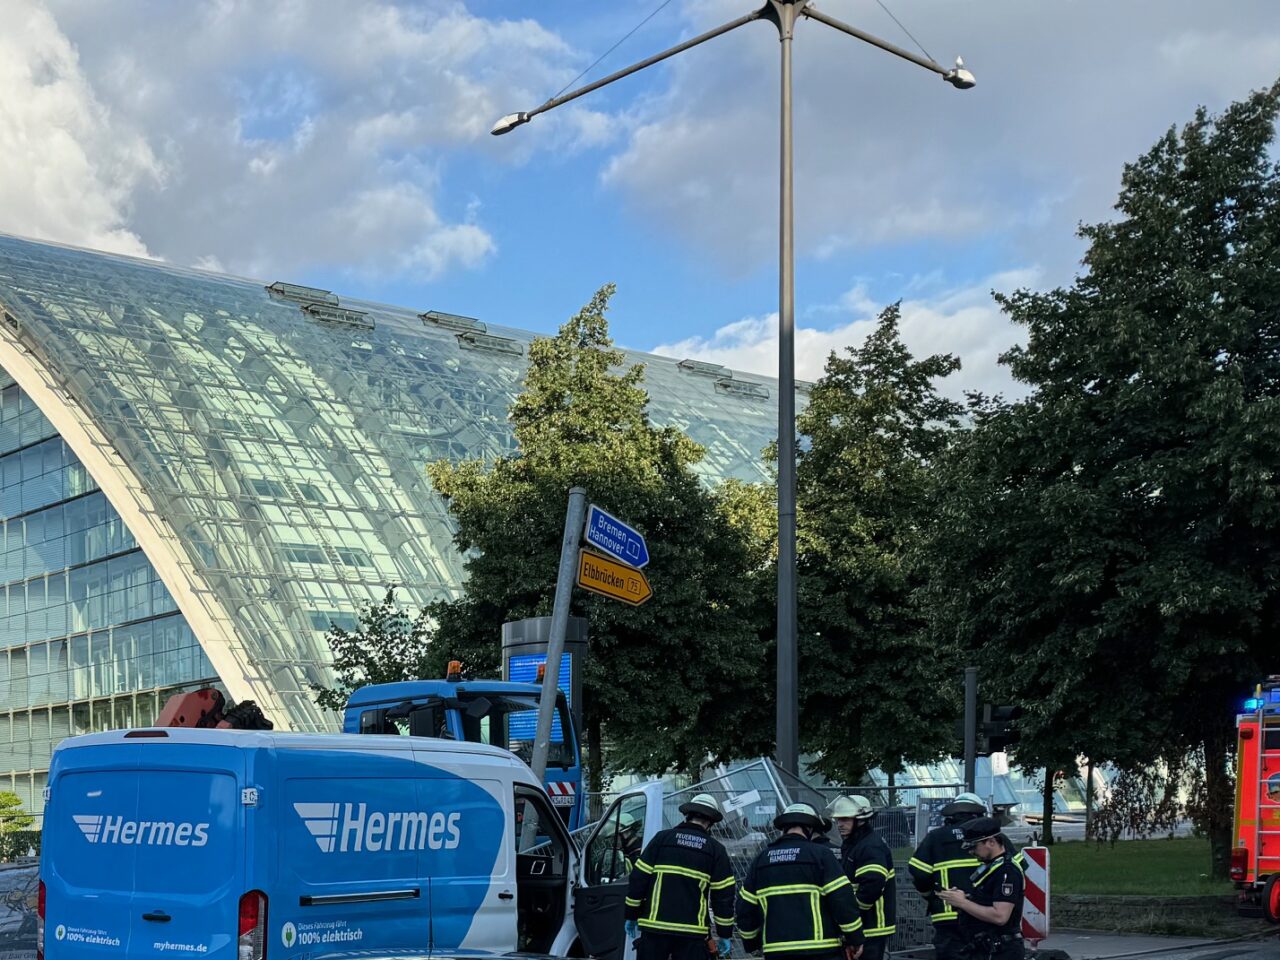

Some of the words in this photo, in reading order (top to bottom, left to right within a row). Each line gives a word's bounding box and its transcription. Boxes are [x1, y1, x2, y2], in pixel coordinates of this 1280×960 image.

[598, 515, 627, 542] Bremen
[589, 524, 625, 555] Hannover
[583, 562, 625, 589] Elbbrücken
[630, 580, 639, 591] 75
[101, 815, 210, 847] Hermes
[341, 803, 461, 852] Hermes
[676, 833, 707, 844] FEUERWEHR
[677, 839, 703, 849] HAMBURG
[768, 848, 801, 857] FEUERWEHR
[769, 854, 796, 863] HAMBURG
[67, 932, 85, 942] 100%
[86, 934, 120, 947] elektrisch
[298, 932, 320, 945] 100%
[322, 928, 363, 943] elektrisch
[153, 941, 208, 953] myhermes.de
